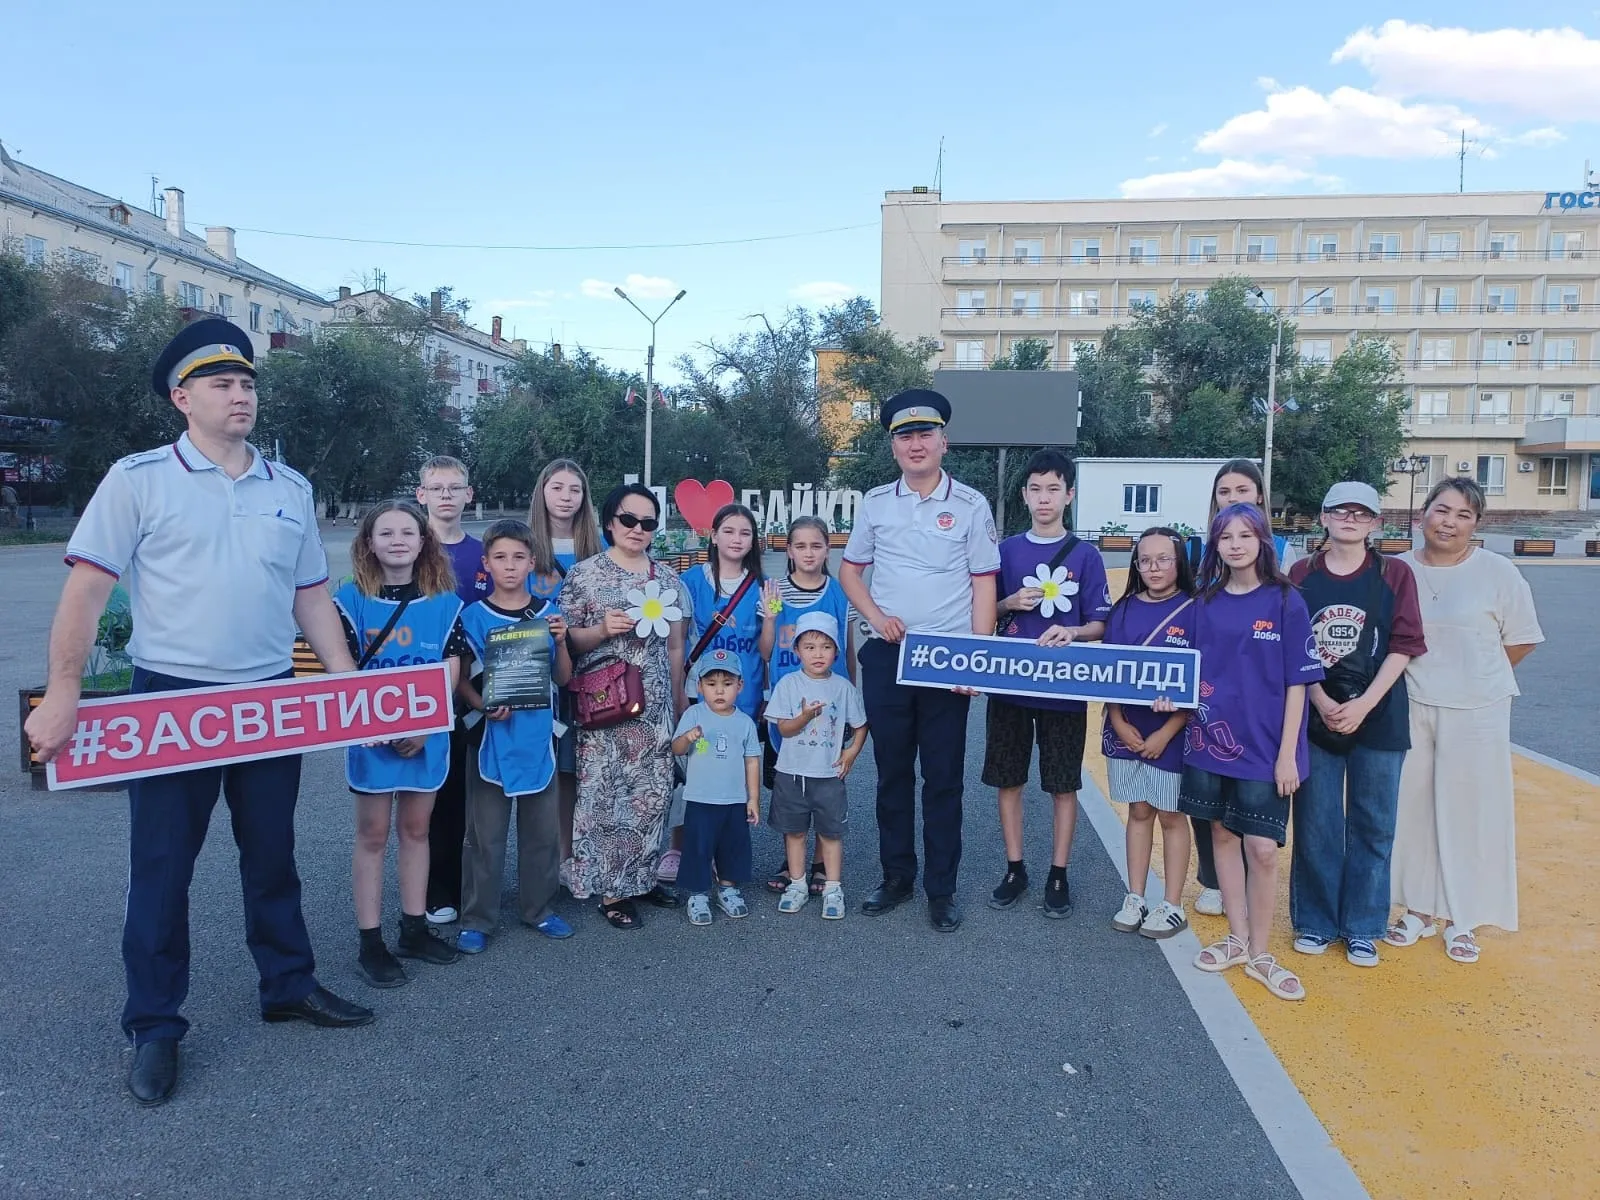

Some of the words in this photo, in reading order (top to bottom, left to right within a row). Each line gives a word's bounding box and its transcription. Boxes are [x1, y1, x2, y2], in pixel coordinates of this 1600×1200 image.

[1320, 607, 1353, 624] MADE
[1331, 626, 1355, 637] 1954
[911, 644, 1186, 692] #СоблюдаемПДД
[69, 683, 438, 767] #ЗАСВЕТИСЬ
